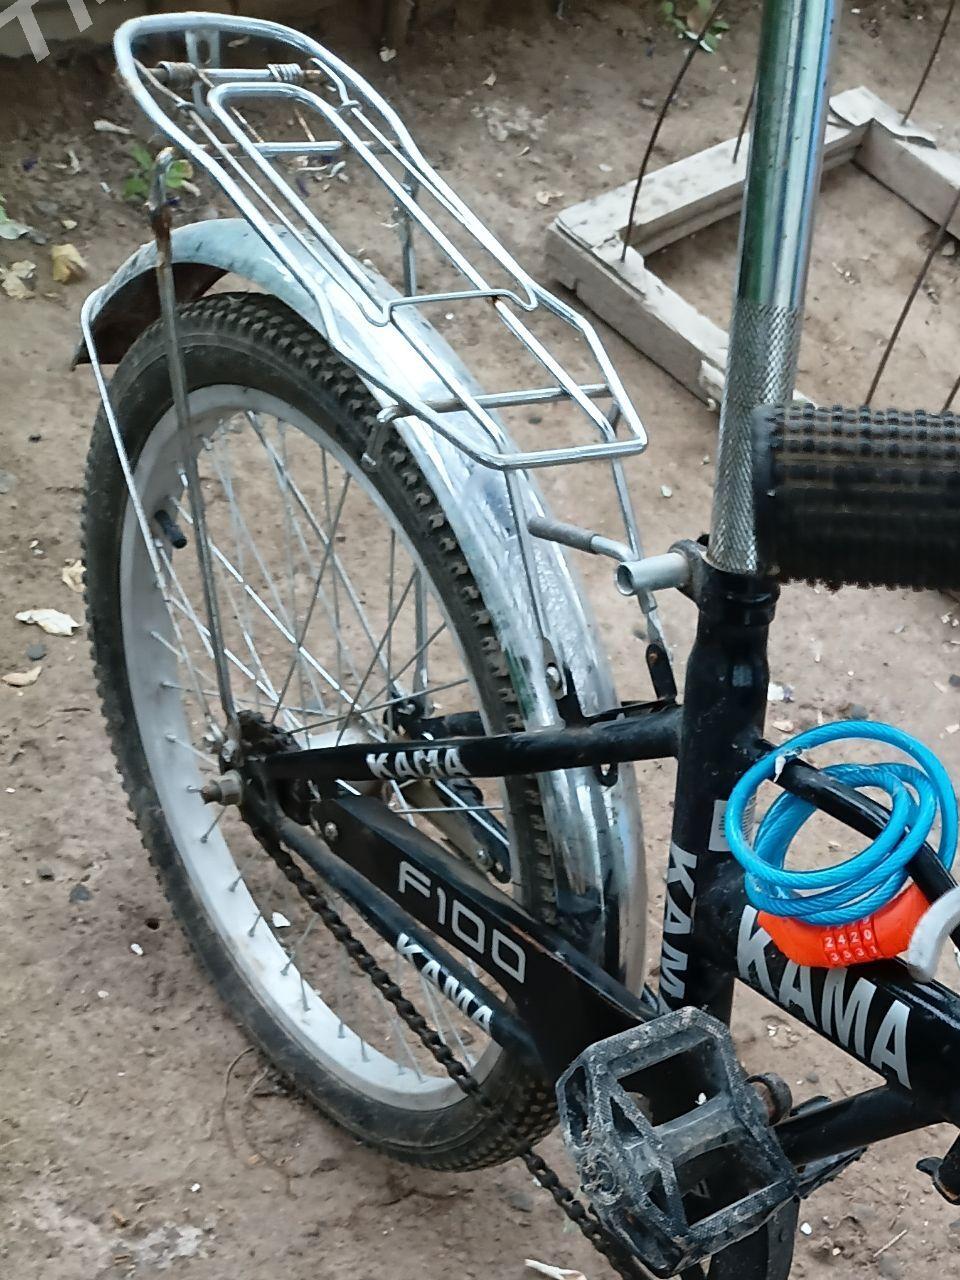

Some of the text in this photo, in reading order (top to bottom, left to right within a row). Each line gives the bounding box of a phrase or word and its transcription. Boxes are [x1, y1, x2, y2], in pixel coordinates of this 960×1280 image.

[366, 748, 470, 778] KAMA
[398, 860, 526, 983] F100
[658, 841, 698, 1015] KAM
[825, 929, 872, 948] 2420
[397, 933, 494, 1032] KAMA
[737, 904, 912, 1090] KAMA
